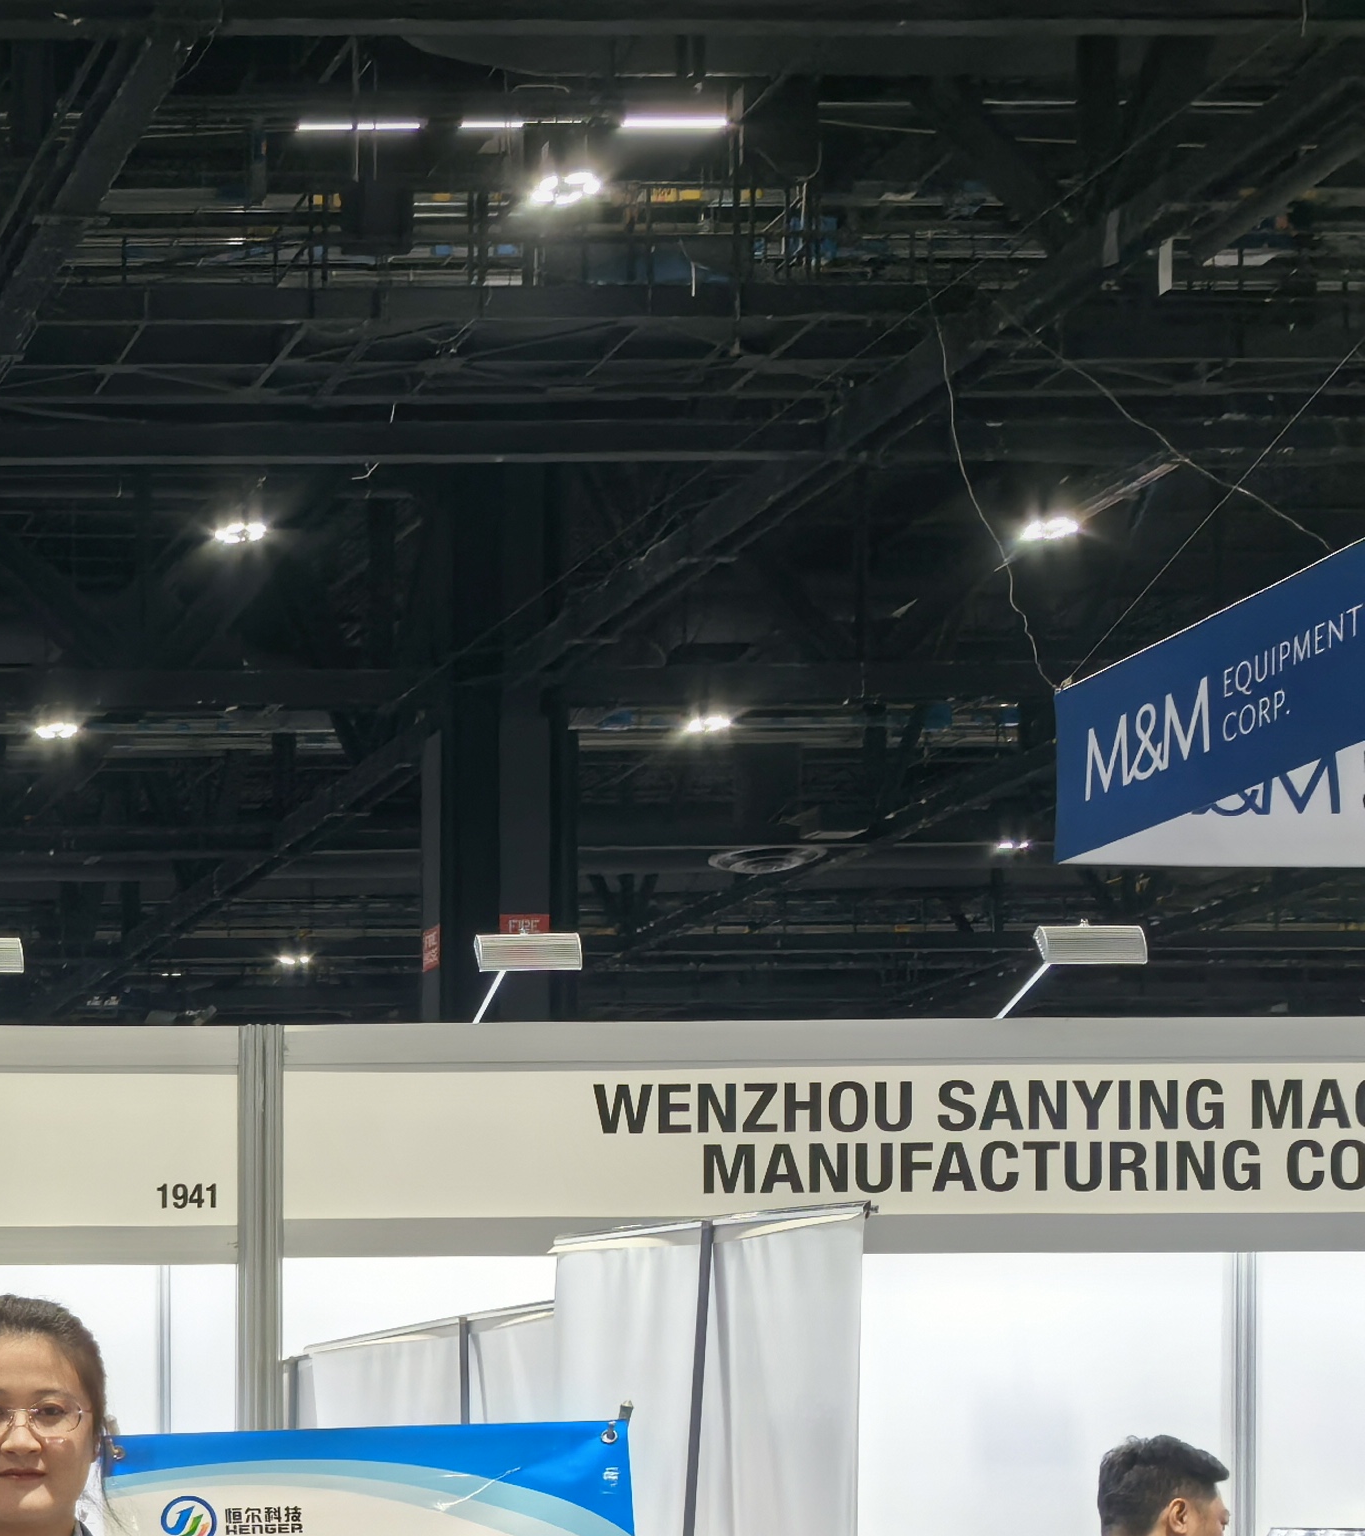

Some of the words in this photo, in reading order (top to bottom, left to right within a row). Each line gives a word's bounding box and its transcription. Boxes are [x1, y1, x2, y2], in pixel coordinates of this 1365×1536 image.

[1223, 602, 1363, 698] EQUIPMENT
[1085, 676, 1210, 802] M&M
[1223, 689, 1291, 742] CORP.
[592, 1080, 914, 1135] WENZHOU
[936, 1078, 1225, 1131] SANYING
[1251, 1078, 1365, 1130] MA
[702, 1138, 1262, 1195] MANUFACTURING
[1287, 1139, 1365, 1191] CO
[156, 1182, 218, 1210] 1941
[225, 1506, 302, 1524] 恒尔科技
[225, 1523, 303, 1535] HENGER
